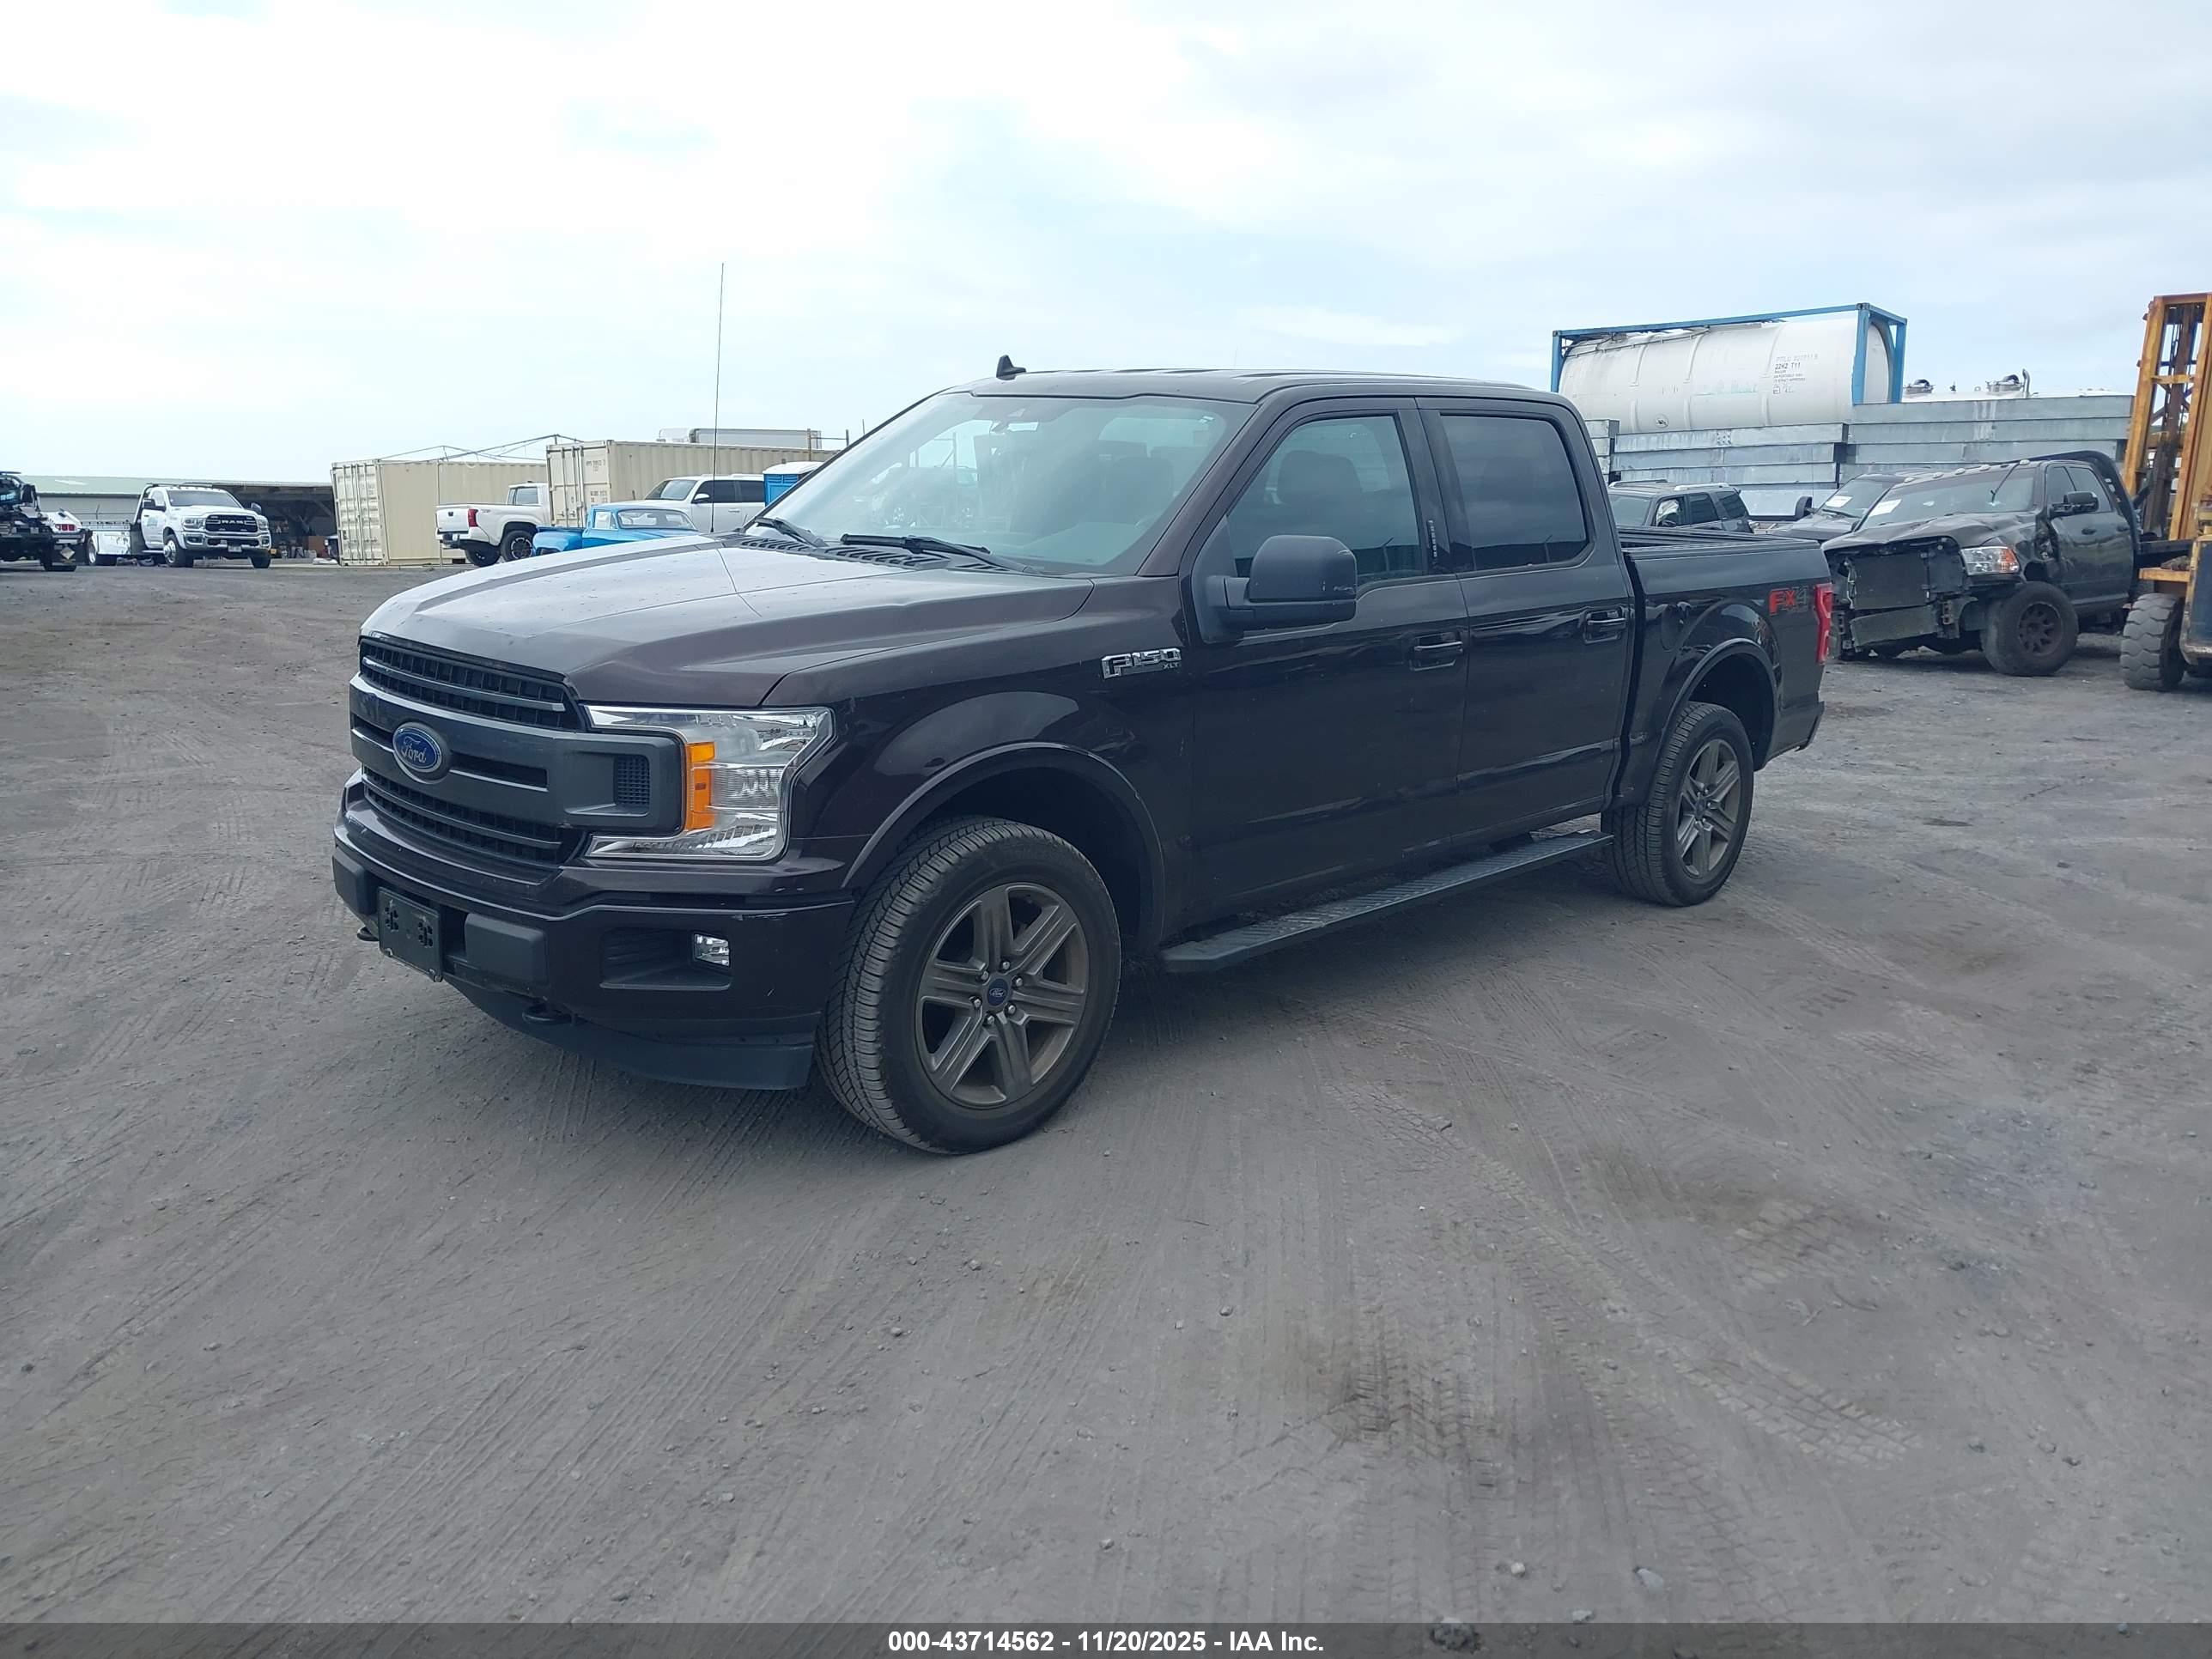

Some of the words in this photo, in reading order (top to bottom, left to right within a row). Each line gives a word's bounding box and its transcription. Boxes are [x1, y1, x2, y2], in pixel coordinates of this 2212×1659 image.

[1769, 585, 1808, 616] FX4
[1163, 661, 1180, 670] XLT
[400, 735, 427, 763] Ford
